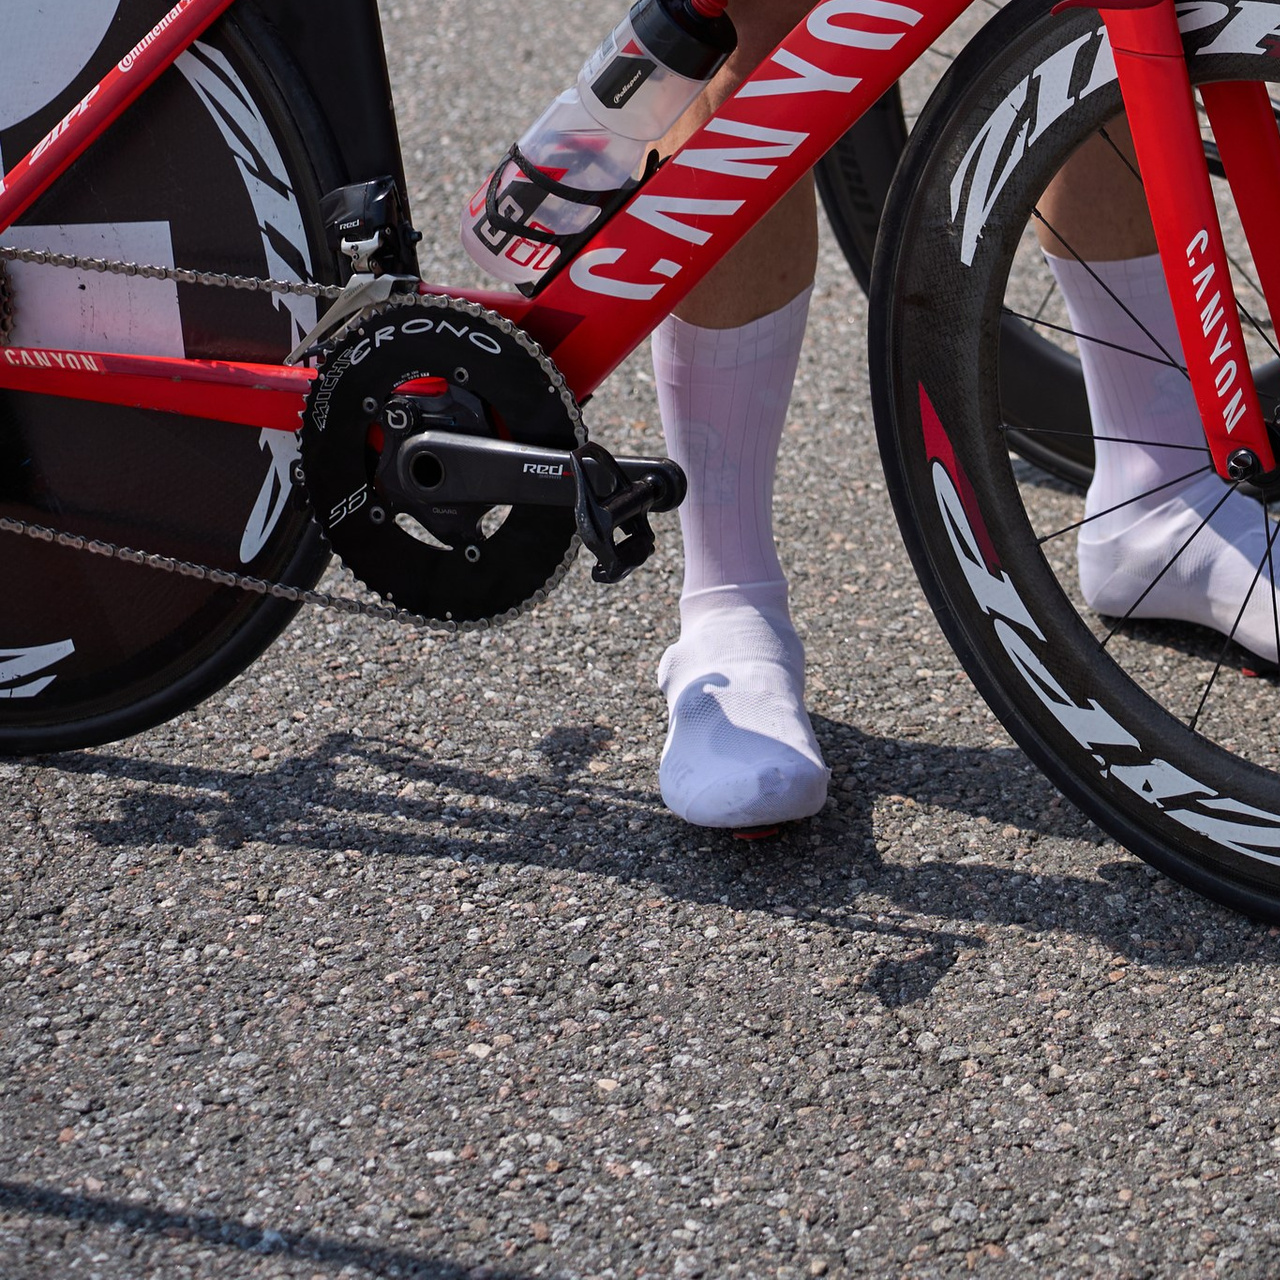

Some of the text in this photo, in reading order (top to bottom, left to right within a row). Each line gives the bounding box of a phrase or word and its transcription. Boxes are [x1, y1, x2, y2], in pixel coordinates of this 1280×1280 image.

[118, 4, 183, 72] Continental
[613, 70, 642, 104] Polisport
[29, 84, 100, 166] ZIPP
[4, 349, 99, 372] CANYON
[350, 318, 502, 365] CRONO
[1186, 229, 1247, 435] CANYON
[312, 346, 358, 432] MICHE
